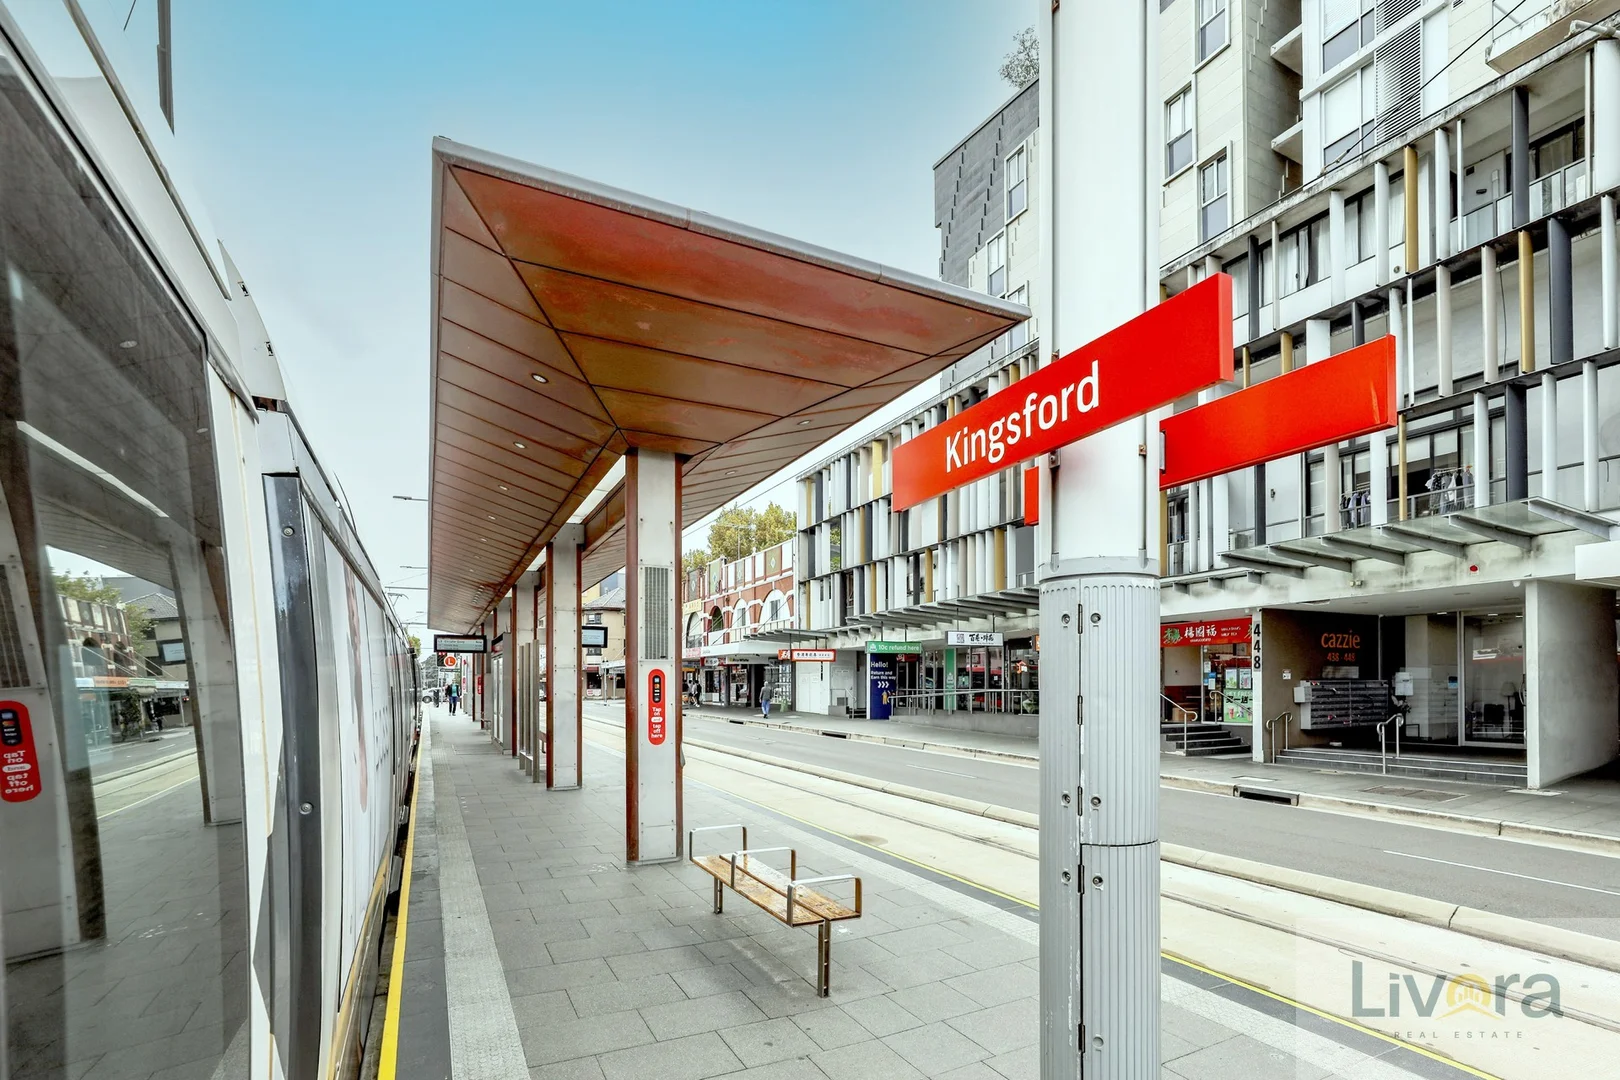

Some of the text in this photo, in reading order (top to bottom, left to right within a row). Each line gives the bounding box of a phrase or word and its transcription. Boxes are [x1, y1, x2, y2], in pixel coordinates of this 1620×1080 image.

[946, 360, 1099, 472] Kingsford
[1253, 623, 1261, 669] 448
[1321, 629, 1360, 649] cazzie
